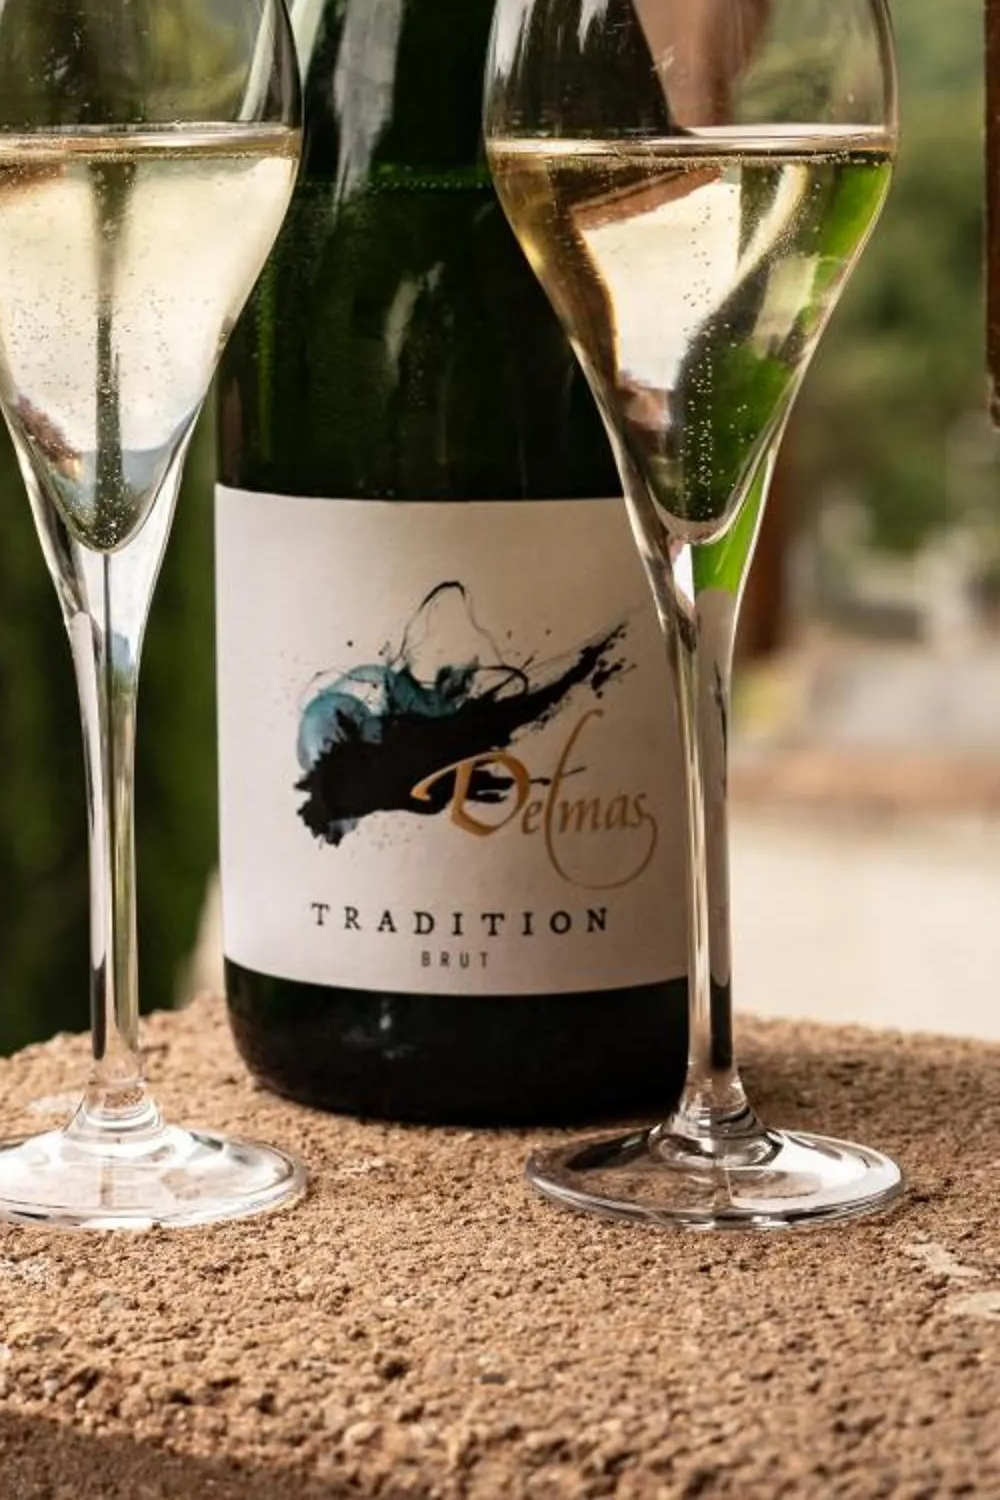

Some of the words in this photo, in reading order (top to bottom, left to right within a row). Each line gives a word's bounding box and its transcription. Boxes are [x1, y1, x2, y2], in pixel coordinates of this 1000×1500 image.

[410, 708, 658, 890] Delmas
[311, 903, 609, 936] TRADITION
[421, 950, 489, 969] BRUT
